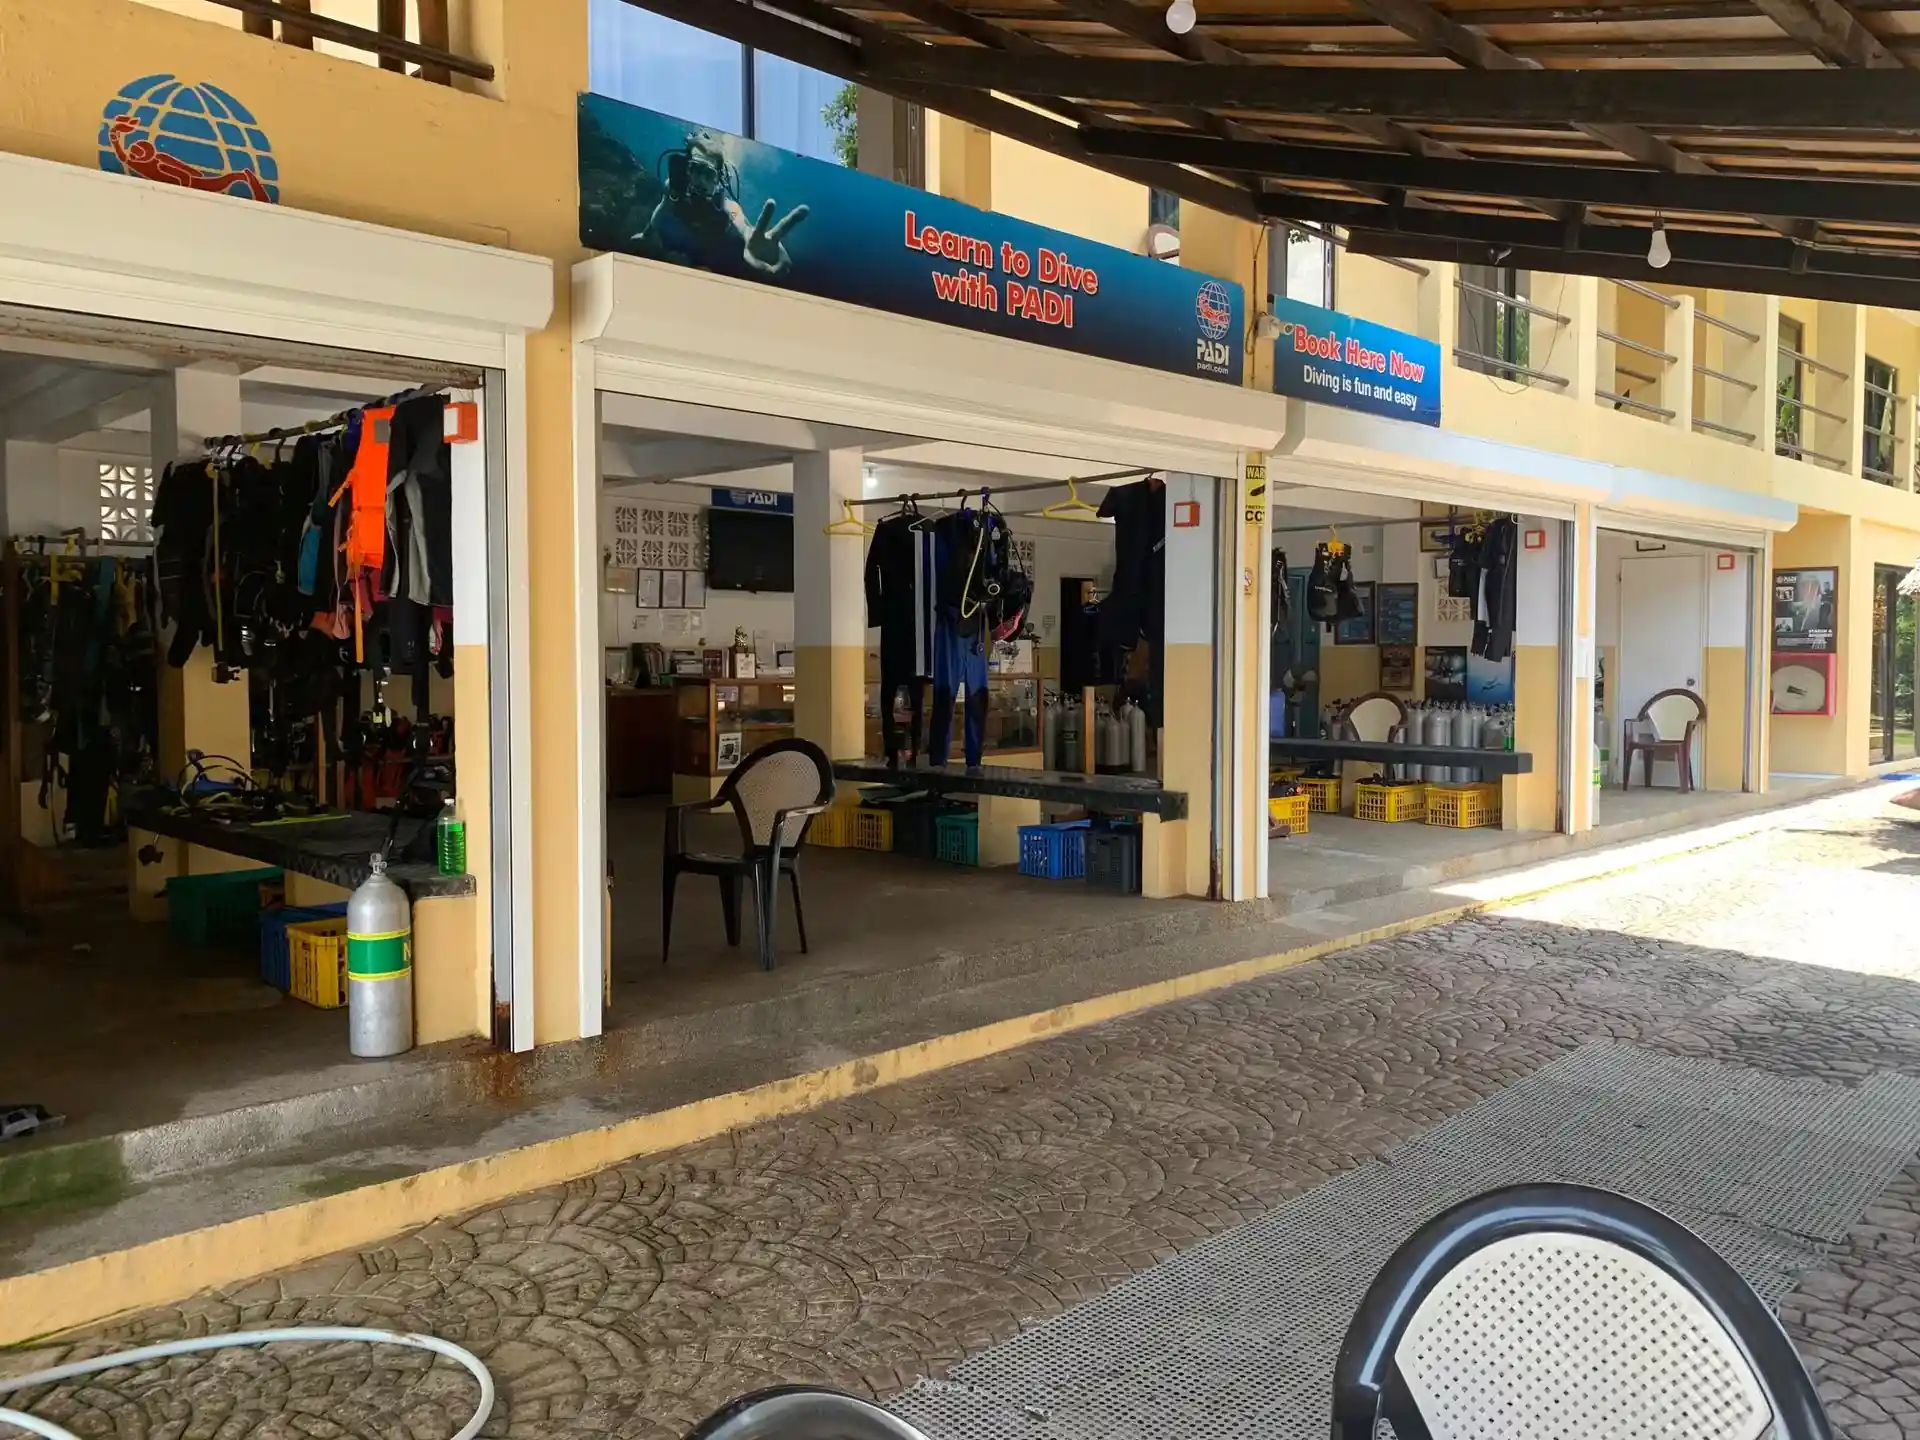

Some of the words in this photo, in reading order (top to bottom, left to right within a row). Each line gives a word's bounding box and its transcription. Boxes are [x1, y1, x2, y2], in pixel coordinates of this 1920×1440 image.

[905, 210, 993, 269] Learn
[1001, 241, 1030, 277] to
[1038, 248, 1098, 294] Dive
[932, 268, 997, 312] with
[1006, 280, 1074, 328] PADI
[1197, 338, 1230, 366] PADI
[1197, 362, 1229, 375] padi.com
[1294, 324, 1342, 361] Book
[1345, 337, 1386, 373] Here
[1390, 350, 1425, 383] Now
[1304, 364, 1340, 393] Diving
[1342, 374, 1352, 392] is
[1354, 377, 1371, 397] fun
[1374, 385, 1393, 402] and
[1395, 391, 1417, 411] easy
[748, 491, 778, 506] PADI
[1245, 510, 1265, 522] CC
